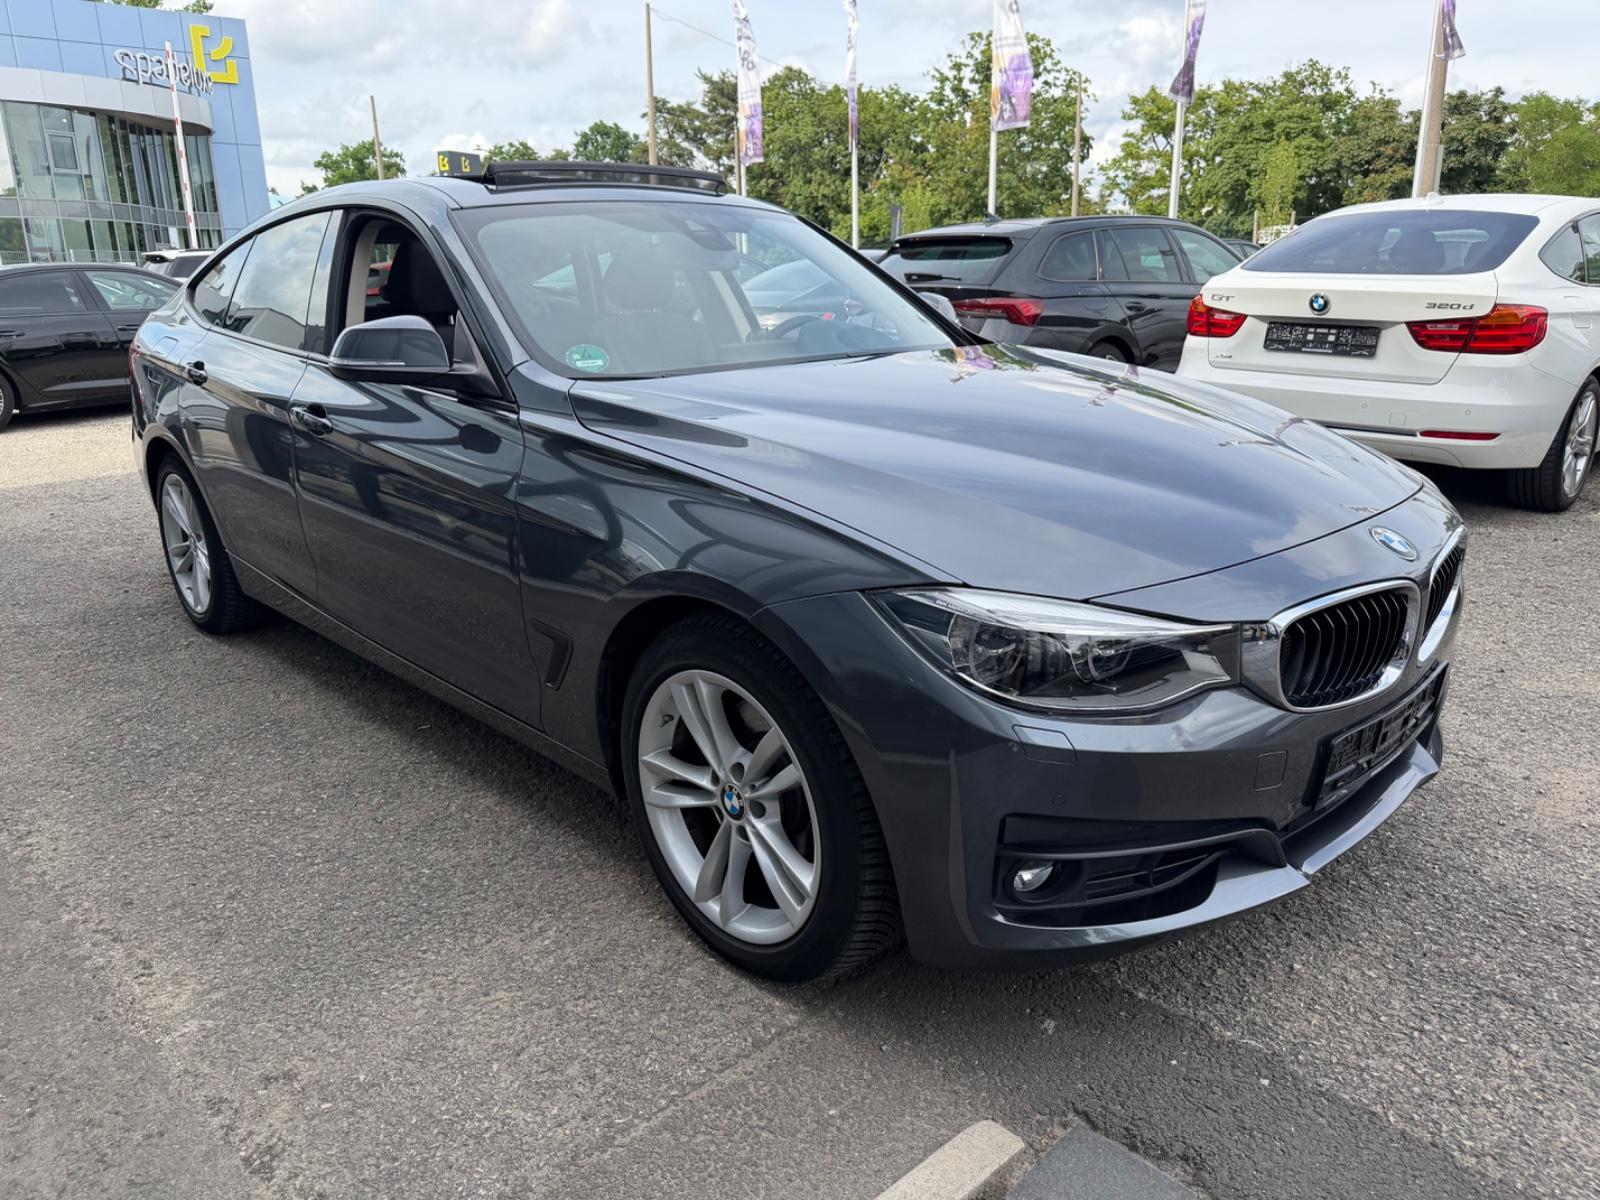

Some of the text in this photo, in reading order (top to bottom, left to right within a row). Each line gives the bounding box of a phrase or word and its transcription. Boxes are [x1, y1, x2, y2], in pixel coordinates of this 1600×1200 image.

[113, 49, 214, 95] spateholz
[1211, 294, 1235, 302] GT
[1425, 302, 1475, 311] 320d
